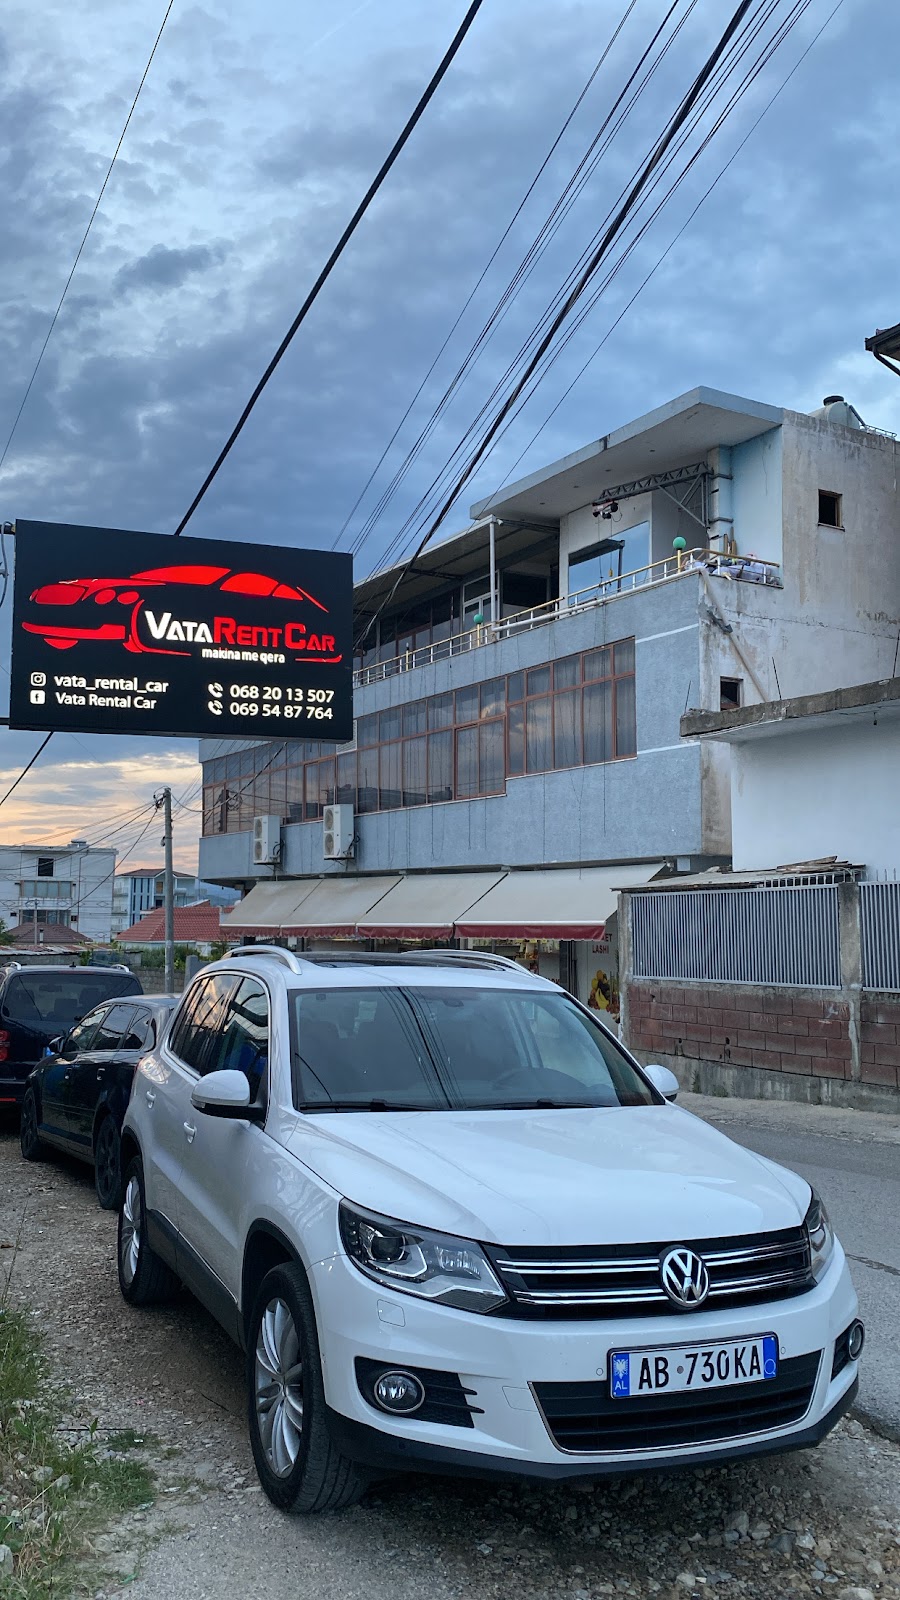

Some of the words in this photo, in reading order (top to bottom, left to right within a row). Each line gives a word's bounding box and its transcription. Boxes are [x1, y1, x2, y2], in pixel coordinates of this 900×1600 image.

[201, 647, 241, 660] makina
[242, 652, 259, 662] me
[260, 653, 286, 665] qera
[53, 674, 169, 694] vata_rental_car
[55, 691, 86, 706] Vata
[88, 693, 132, 708] Rental
[133, 696, 157, 710] Car
[229, 684, 260, 699] 068
[262, 686, 282, 701] 20
[286, 688, 304, 702] 13
[307, 689, 335, 704] 507
[229, 702, 259, 717] 069
[262, 704, 281, 718] 54
[284, 705, 303, 719] 87
[306, 706, 333, 720] 764
[614, 1381, 628, 1390] AL
